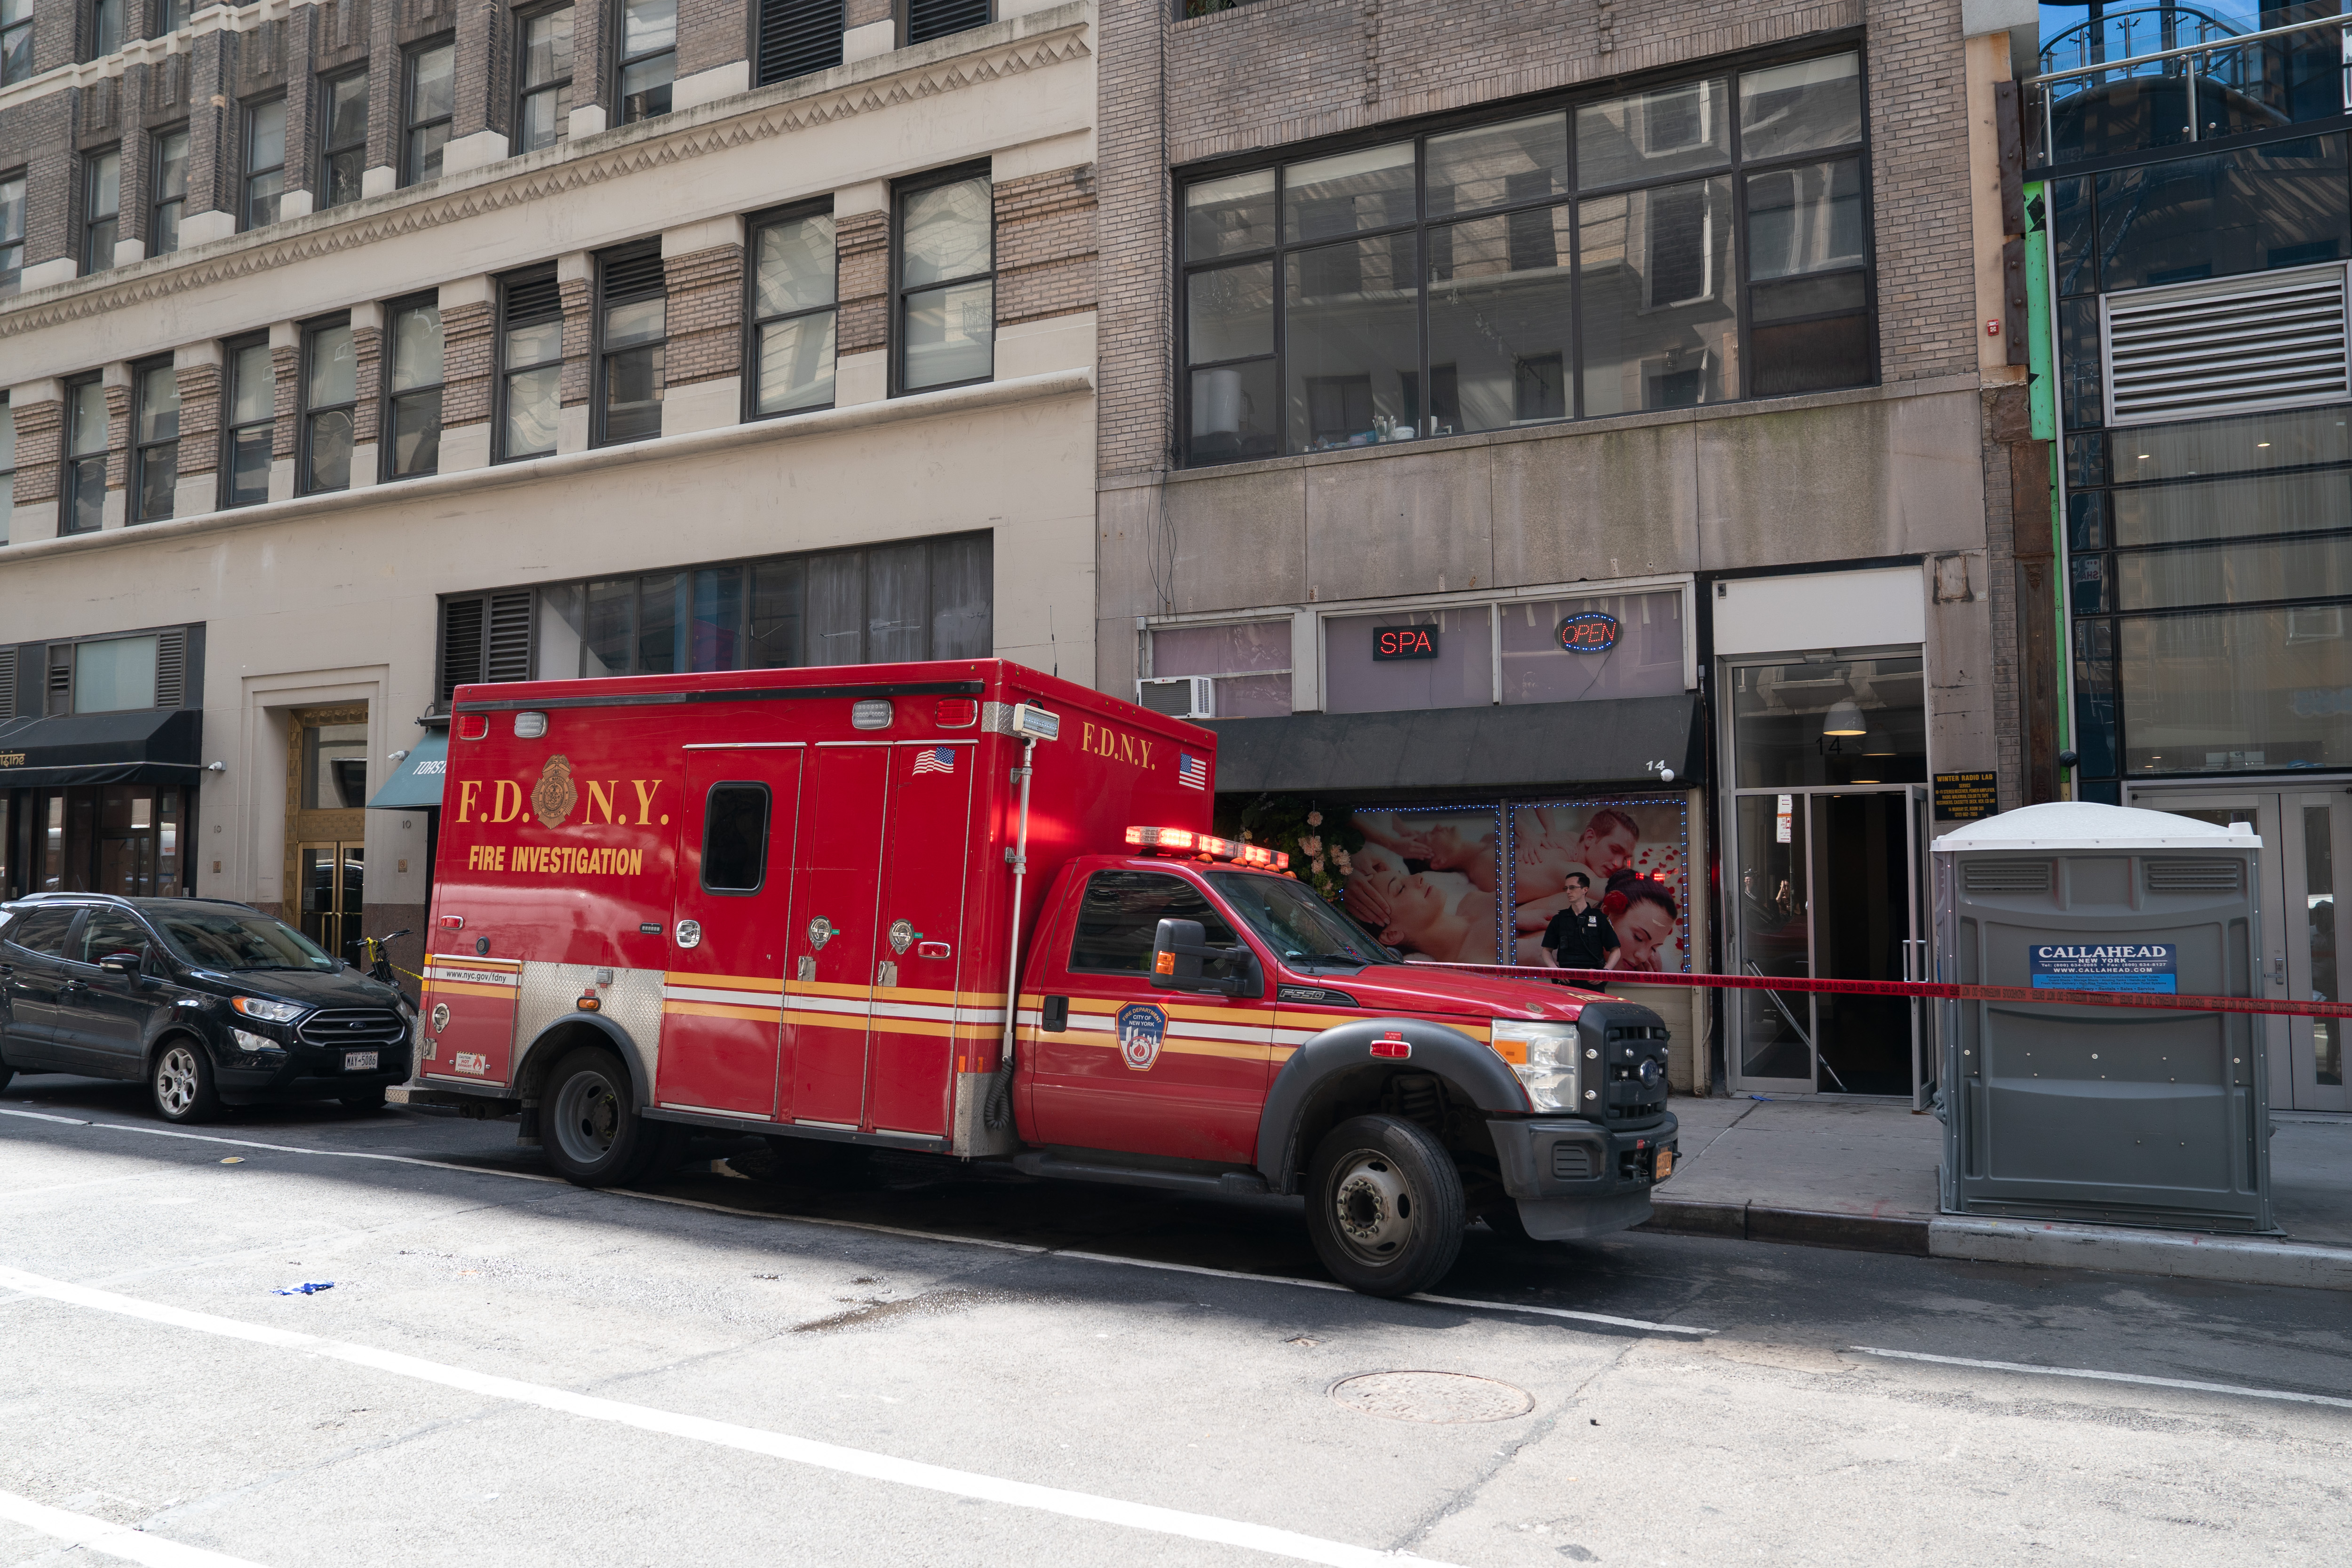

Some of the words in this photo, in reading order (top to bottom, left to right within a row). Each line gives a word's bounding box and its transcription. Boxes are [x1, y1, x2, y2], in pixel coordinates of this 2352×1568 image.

[1562, 621, 1617, 644] OPEN
[1380, 630, 1432, 654] SPA
[1816, 736, 1843, 756] 14
[0, 750, 25, 767] isine
[413, 761, 447, 775] TOAST
[1645, 760, 1666, 771] 14
[403, 820, 411, 829] 10
[469, 845, 505, 871] FIRE
[511, 846, 643, 876] INVESTIGATION
[2039, 946, 2166, 958] CALLAHEAD
[446, 971, 507, 983] www.nyc.gov/fdny
[2179, 997, 2204, 1008] HAZARDOUS
[2273, 1001, 2300, 1012] HAZARDOUS
[1122, 1011, 1133, 1021] FIRE
[1132, 1007, 1162, 1023] DEPARTMENT
[362, 1055, 376, 1066] 5086
